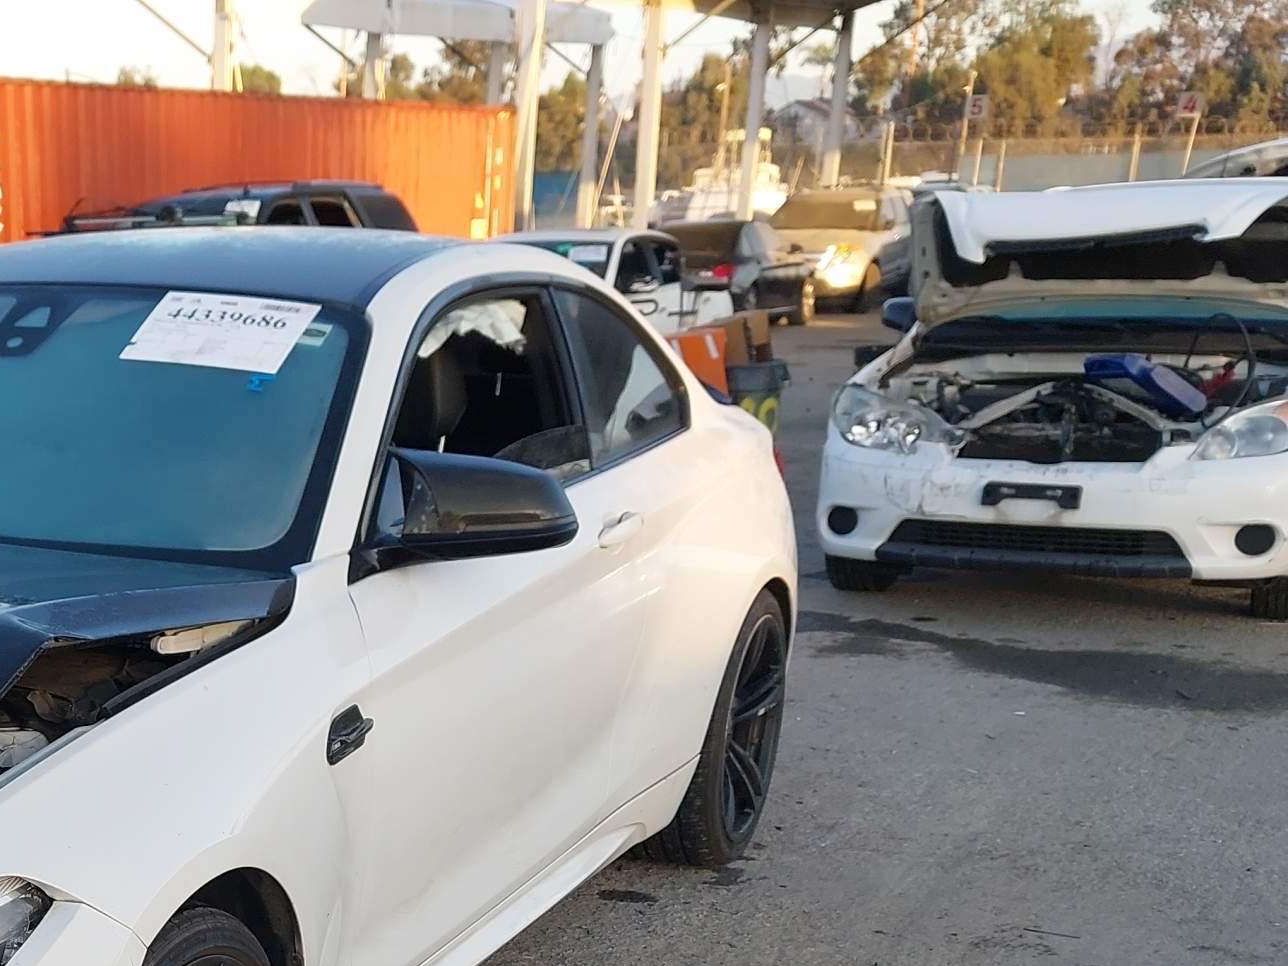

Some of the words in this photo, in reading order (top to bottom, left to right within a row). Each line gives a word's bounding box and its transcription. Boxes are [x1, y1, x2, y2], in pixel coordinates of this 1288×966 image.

[969, 96, 983, 115] 5
[1182, 97, 1198, 113] 4
[167, 307, 287, 329] 44339686
